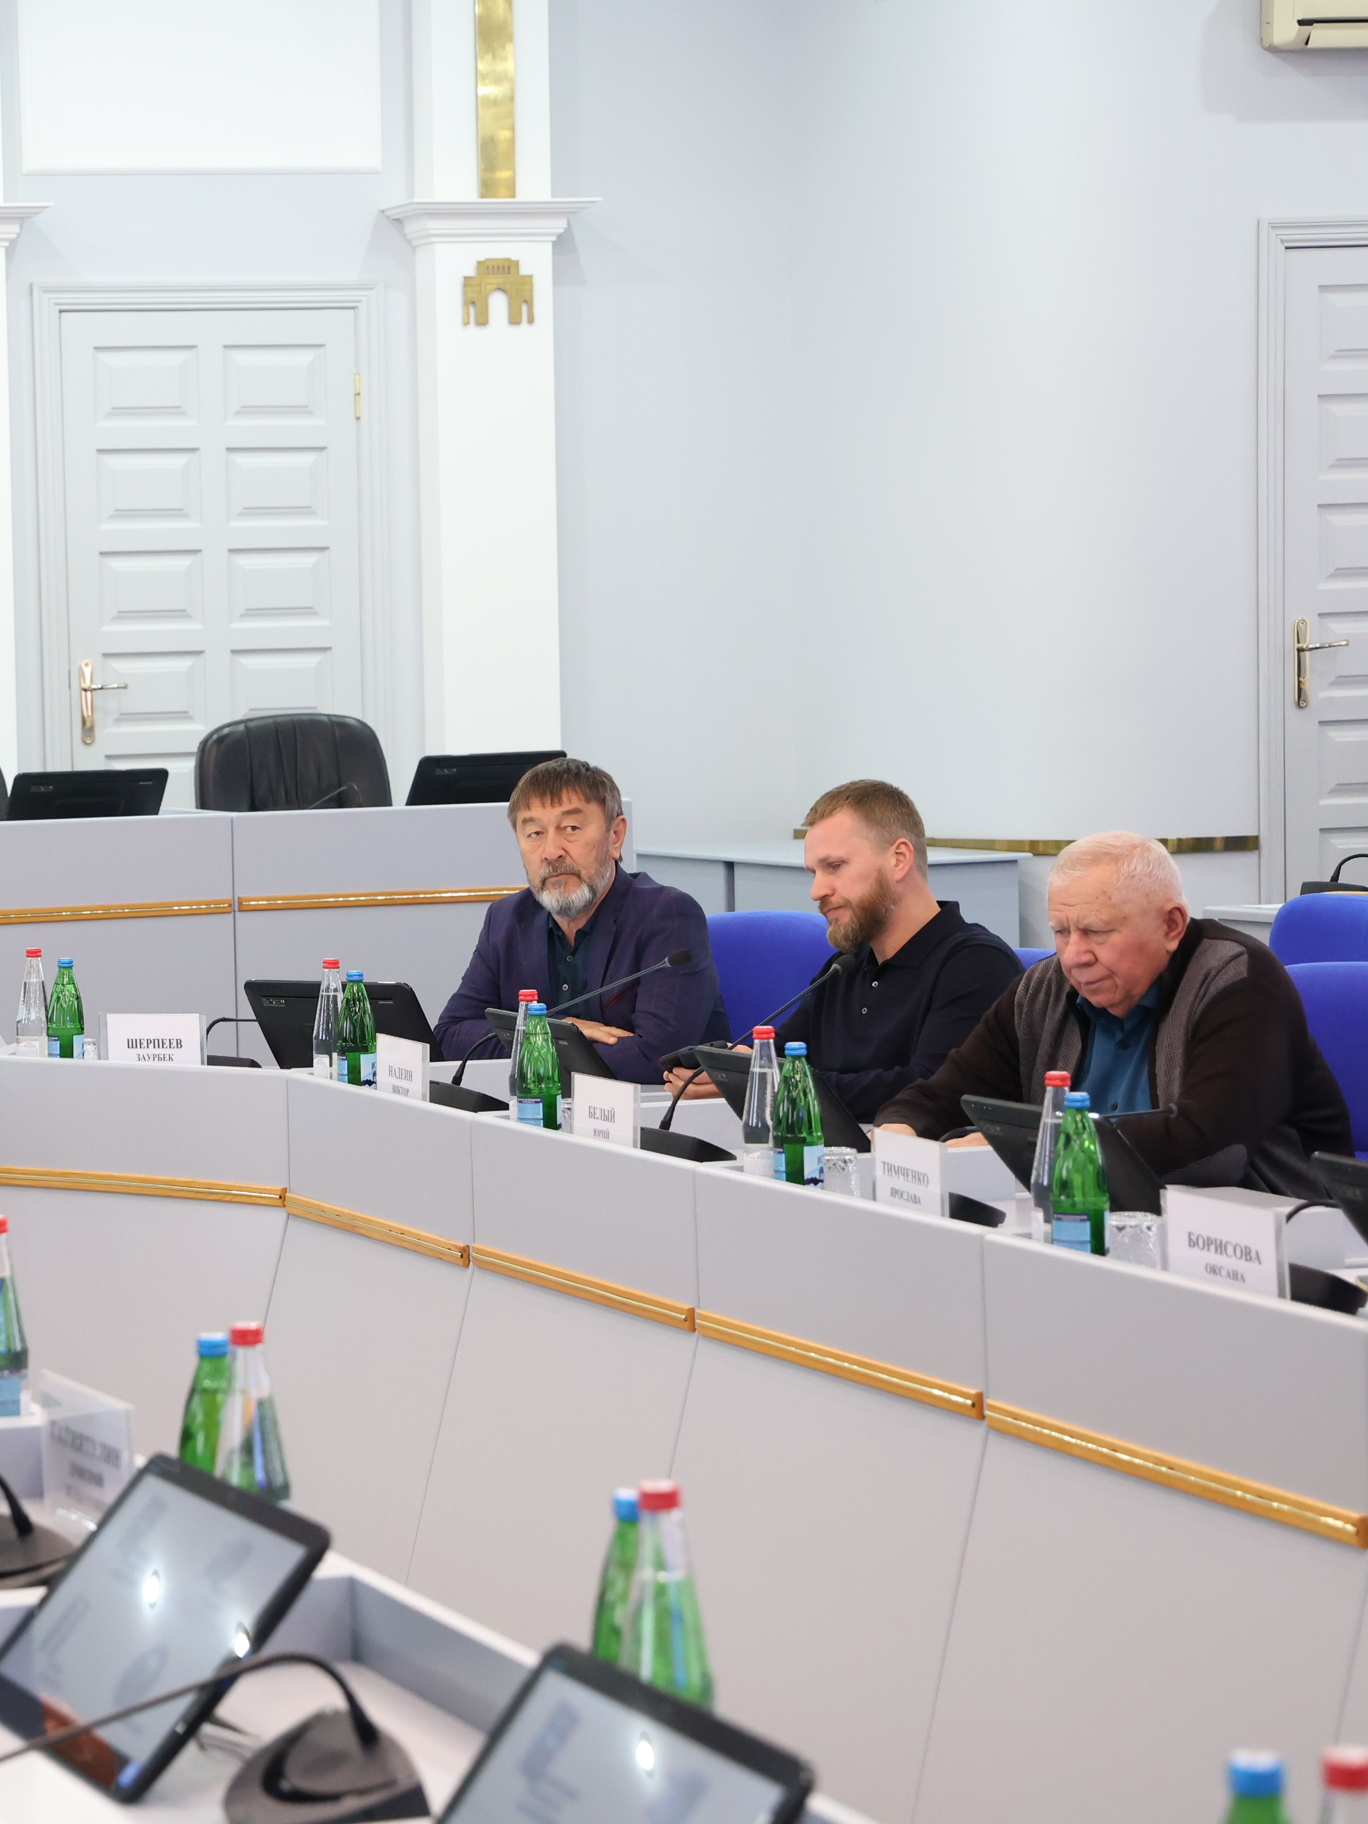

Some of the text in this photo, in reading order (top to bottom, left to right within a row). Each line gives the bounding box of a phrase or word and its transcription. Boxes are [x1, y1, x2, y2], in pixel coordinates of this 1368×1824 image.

[126, 1038, 183, 1050] ШЕРПЕЕВ
[135, 1053, 174, 1062] ЗАУРБЕК
[588, 1105, 616, 1124] БЕЛЫЙ
[593, 1127, 610, 1140] ЮРИЙ
[881, 1161, 930, 1189] ТИМЧЕНКО
[890, 1186, 922, 1206] ЯРОСЛАВА
[1187, 1231, 1263, 1266] БОРИСОВА
[1205, 1261, 1246, 1284] ОКСАНА
